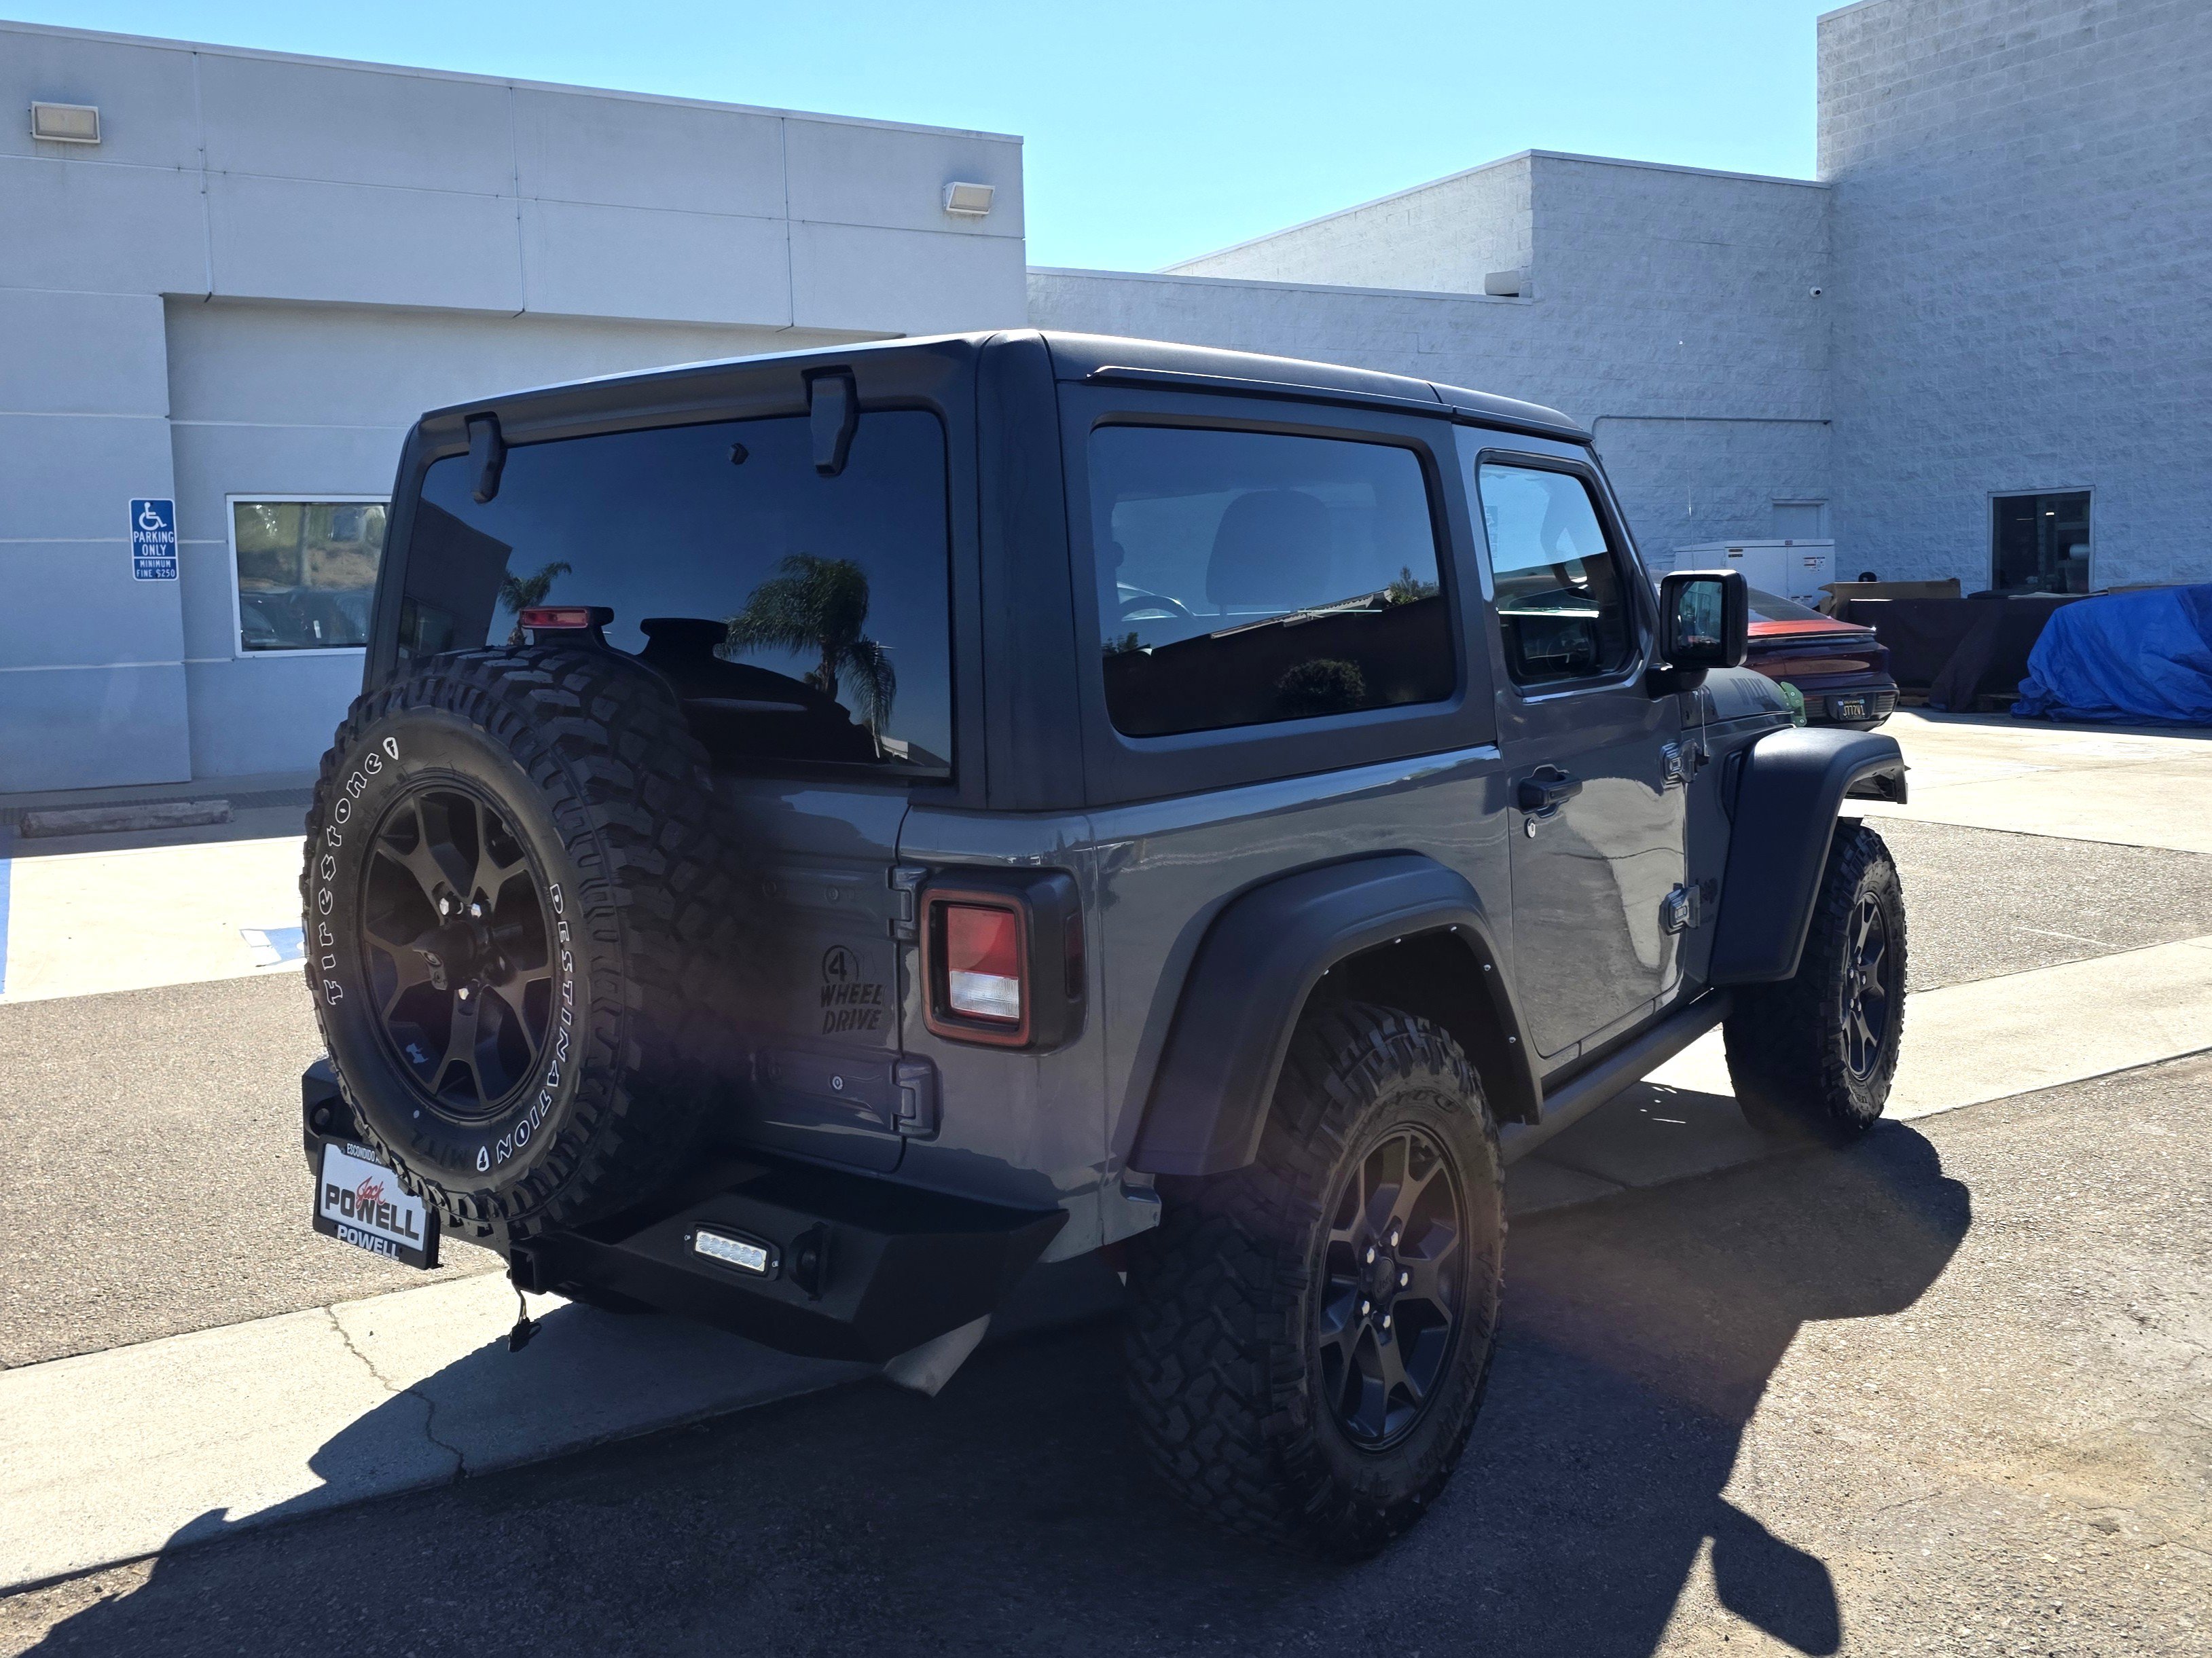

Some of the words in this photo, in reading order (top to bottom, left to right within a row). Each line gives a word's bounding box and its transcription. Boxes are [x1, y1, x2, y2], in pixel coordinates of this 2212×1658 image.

[133, 531, 174, 543] PARKING
[142, 544, 166, 556] ONLY
[137, 569, 153, 577] FINE
[156, 569, 175, 578] $250
[139, 559, 171, 568] MINIMUM
[318, 752, 382, 1006] Firestone
[828, 951, 847, 981] 4
[820, 984, 882, 1008] WHEEL
[496, 883, 573, 1164] DESTINATION
[822, 1008, 882, 1035] DRIVE
[347, 1143, 376, 1162] ESCONDIDO
[356, 1175, 386, 1210] Jack
[325, 1183, 420, 1241] POWELL
[337, 1224, 400, 1261] POWELL
